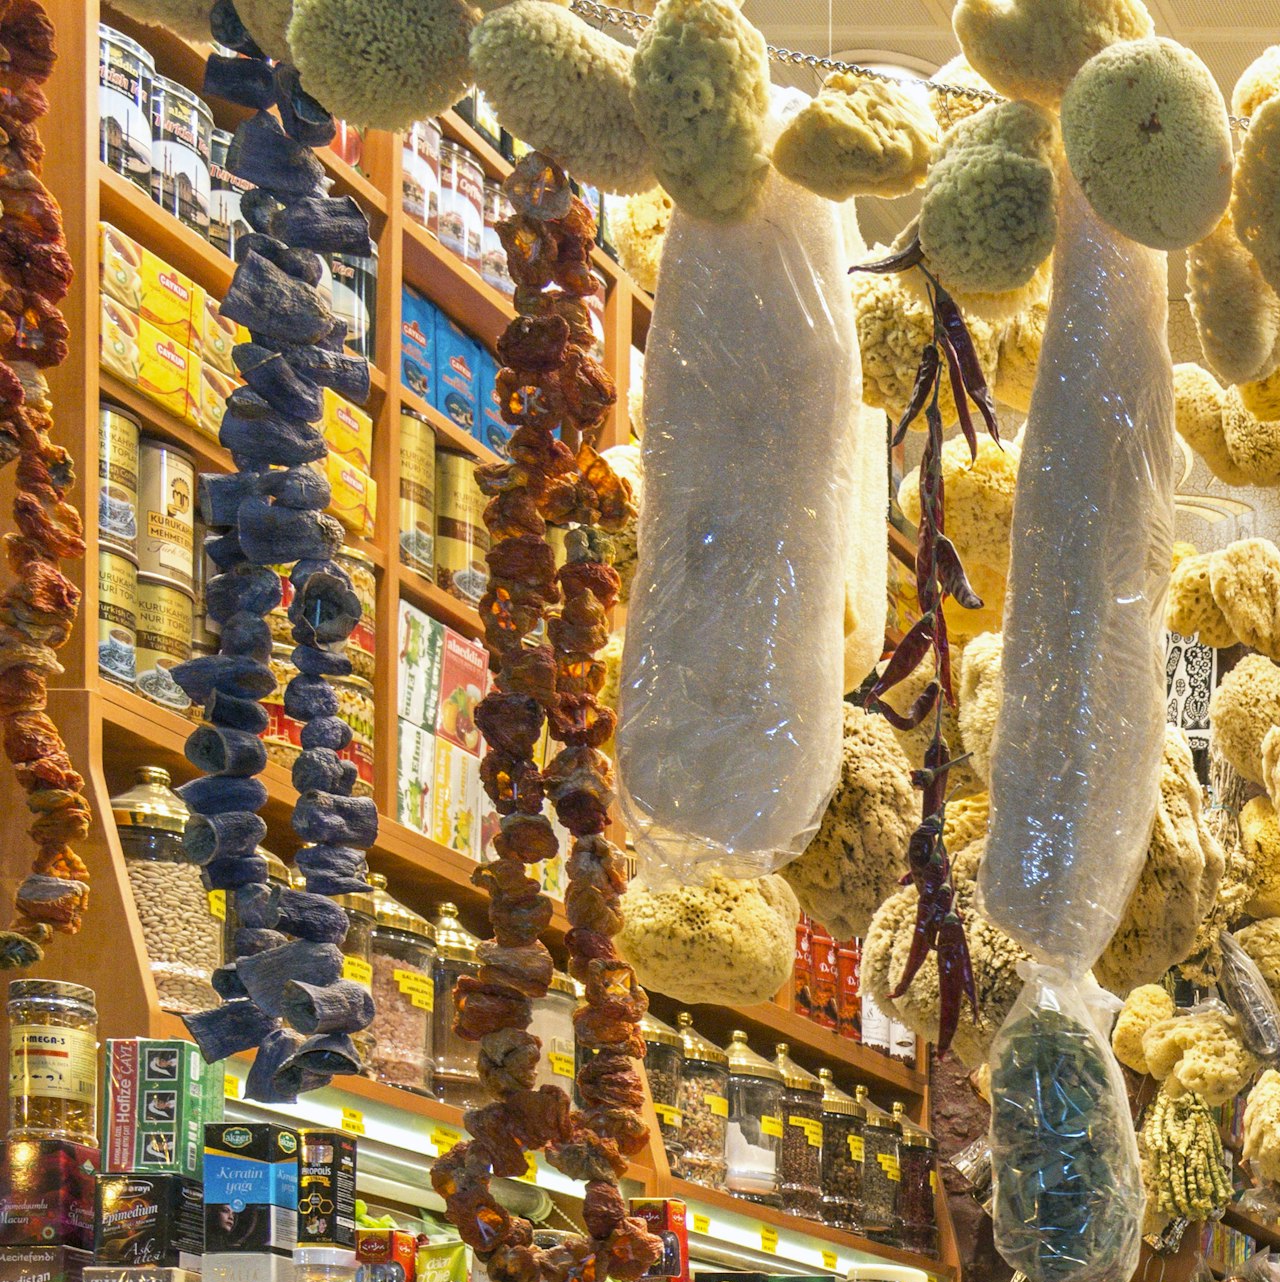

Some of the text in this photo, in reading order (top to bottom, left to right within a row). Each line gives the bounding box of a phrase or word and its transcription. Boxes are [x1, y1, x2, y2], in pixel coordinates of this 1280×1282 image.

[332, 261, 355, 278] Tea
[150, 528, 184, 546] MEHMET
[140, 612, 164, 626] NURİ
[447, 638, 484, 669] alaeddin
[116, 1044, 134, 1124] Hafize ÇAYI
[224, 1131, 250, 1144] akzer
[217, 1166, 264, 1181] Keratin
[226, 1181, 253, 1195] yağı
[102, 1204, 159, 1225] Epimedium
